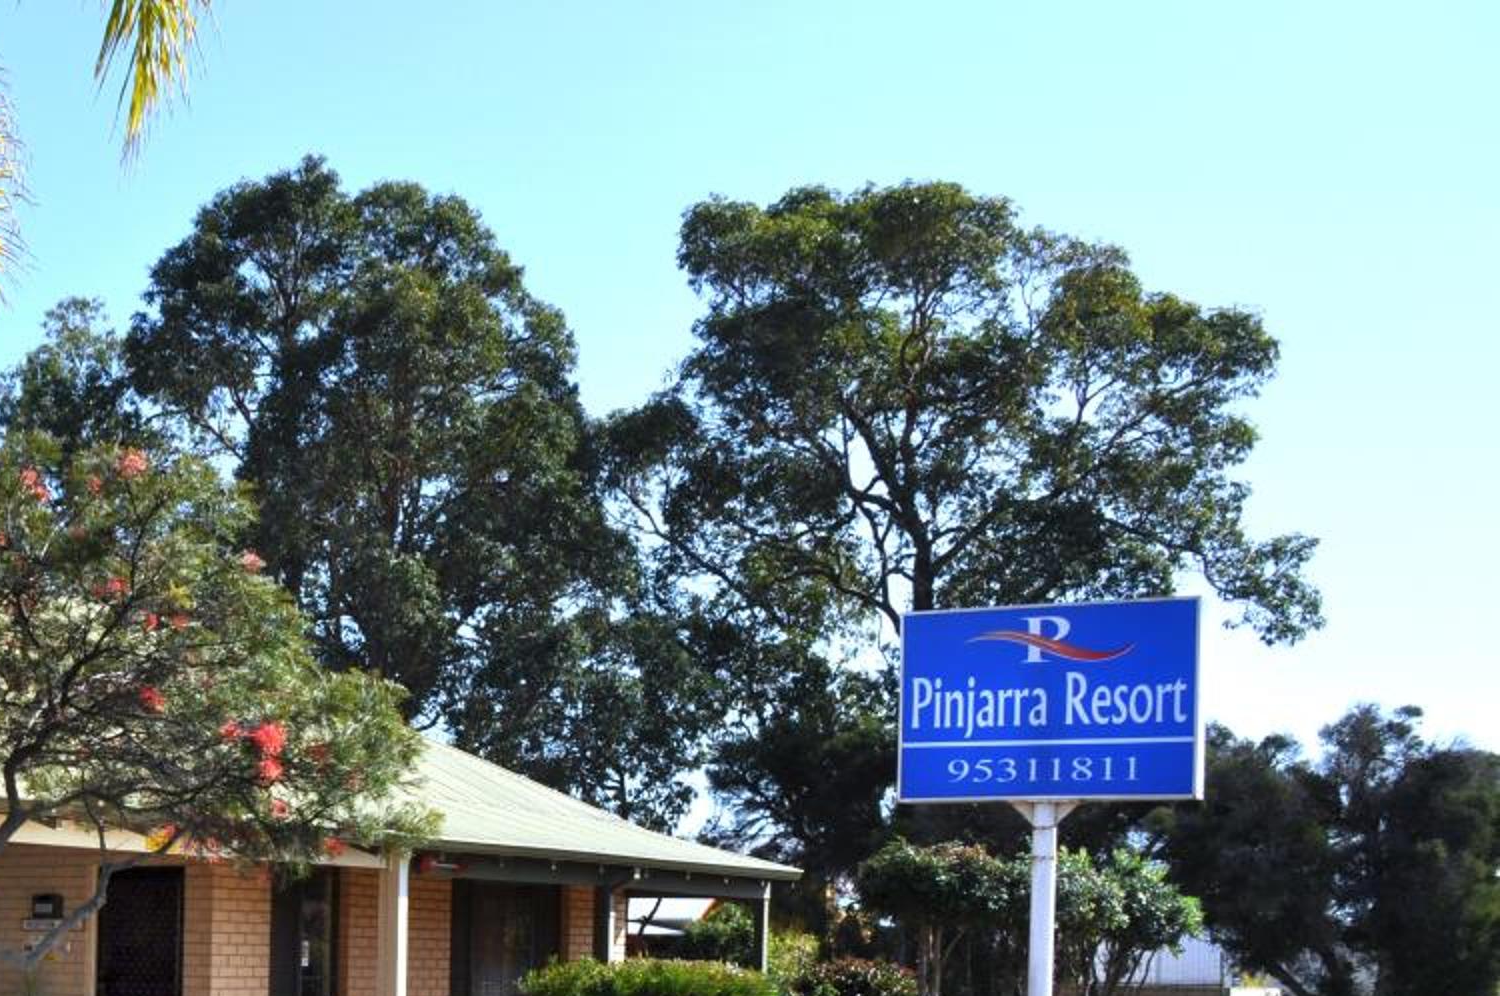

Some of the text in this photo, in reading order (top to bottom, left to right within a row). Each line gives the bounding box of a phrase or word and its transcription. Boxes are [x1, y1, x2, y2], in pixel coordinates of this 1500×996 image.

[911, 671, 1188, 739] Pinjarra Resort
[947, 756, 1142, 783] 95311811
